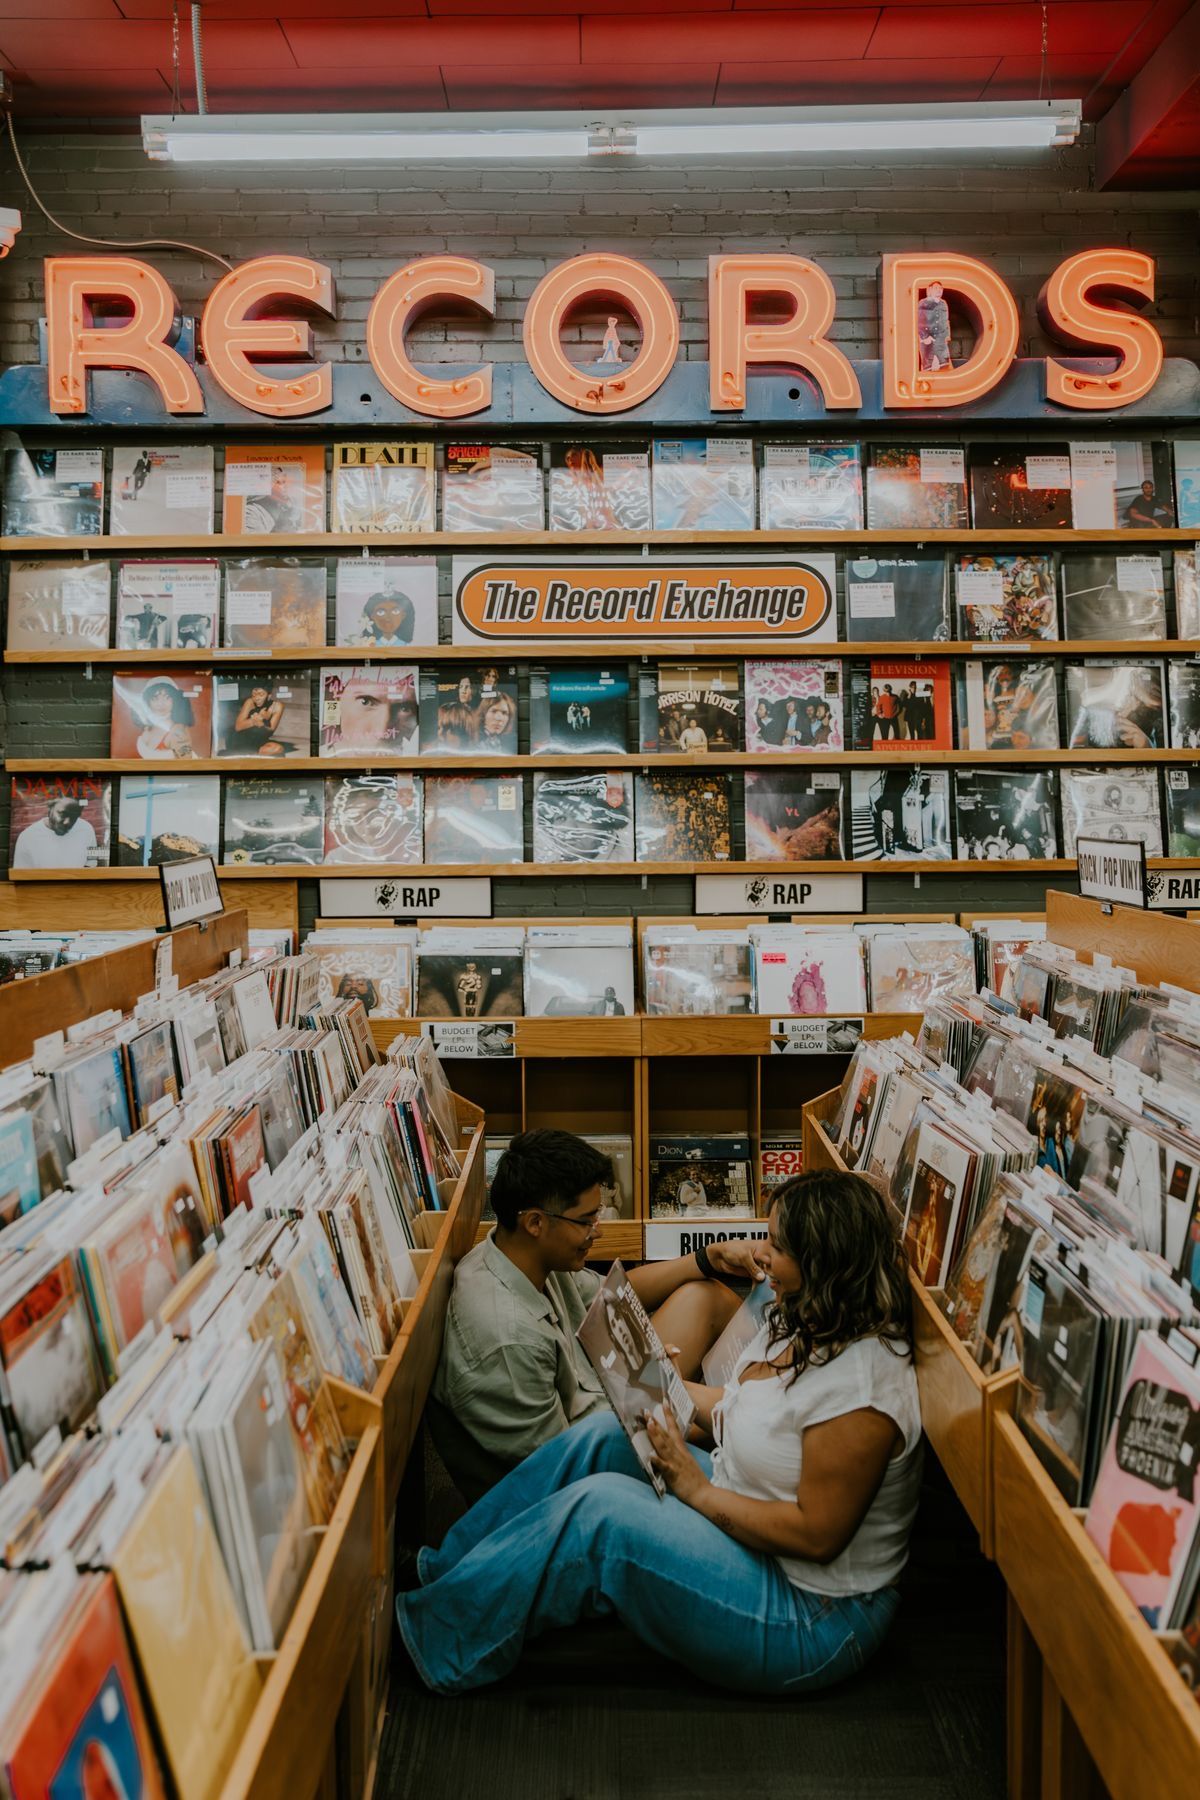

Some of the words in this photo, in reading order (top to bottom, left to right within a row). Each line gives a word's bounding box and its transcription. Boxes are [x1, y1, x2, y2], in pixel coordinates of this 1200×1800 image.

[44, 248, 1163, 418] RECORDS
[340, 447, 428, 464] DEATH
[486, 583, 537, 620] The
[547, 582, 658, 621] Record
[663, 582, 805, 624] Exchange
[873, 664, 937, 675] ELEVISION
[658, 690, 701, 709] RRISON
[704, 690, 740, 716] HOTEL
[1103, 856, 1118, 887] POP
[402, 887, 441, 908] RAP
[773, 884, 812, 905] RAP
[441, 1027, 475, 1035] BUDGET
[791, 1024, 825, 1032] BUDGET
[444, 1045, 474, 1053] BELOW
[793, 1041, 823, 1049] BELOW
